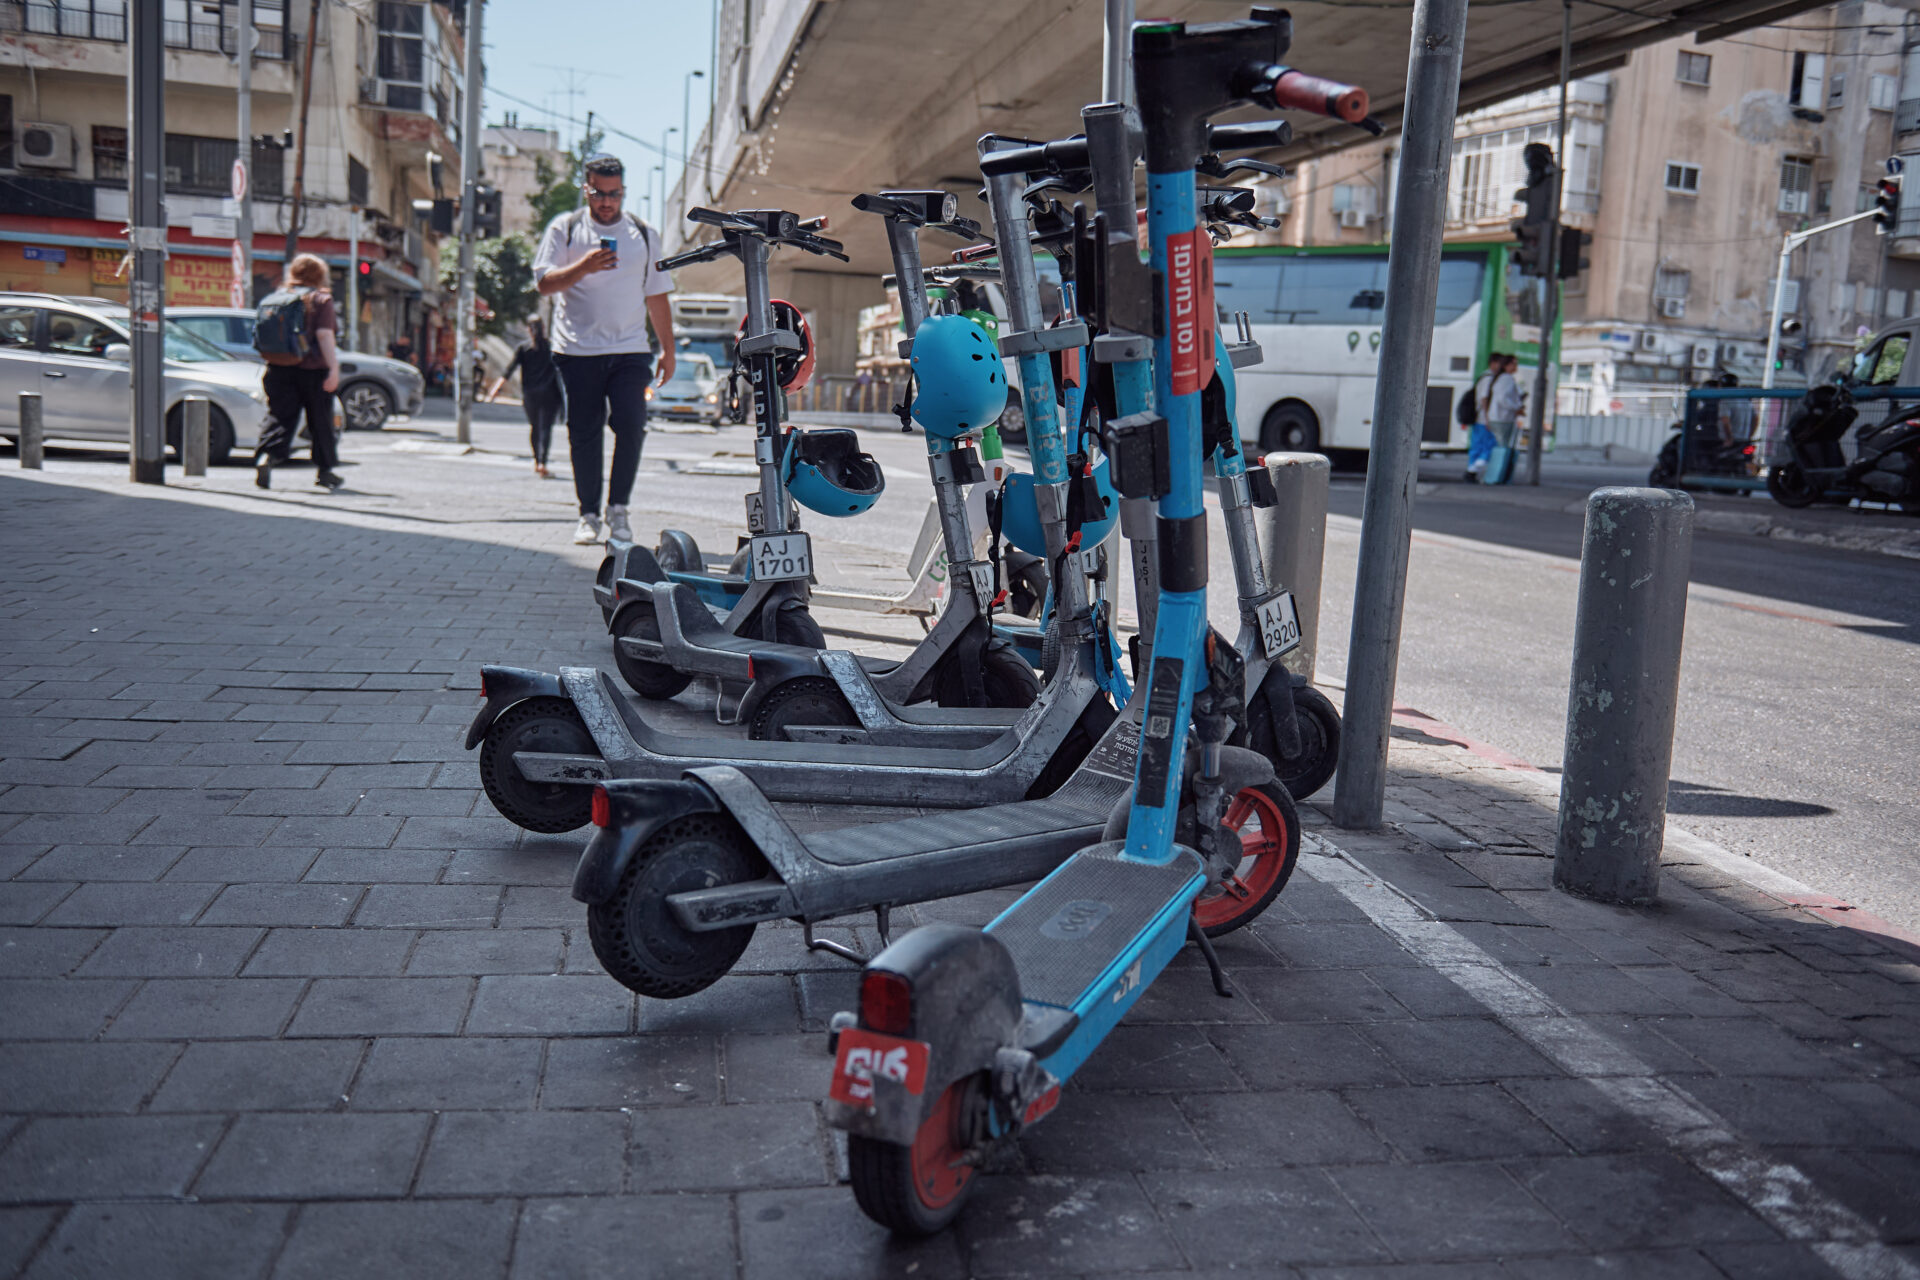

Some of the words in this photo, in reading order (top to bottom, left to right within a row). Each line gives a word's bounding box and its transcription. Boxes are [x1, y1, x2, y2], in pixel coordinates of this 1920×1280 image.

[1173, 243, 1194, 317] בחינם!
[1177, 321, 1194, 354] נסו
[751, 369, 767, 436] BIRD
[1029, 382, 1060, 480] BIRD
[761, 540, 788, 557] AJ
[759, 556, 805, 576] 1701
[975, 568, 989, 588] AJ
[1265, 602, 1282, 628] AJ
[1265, 621, 1296, 652] 2920
